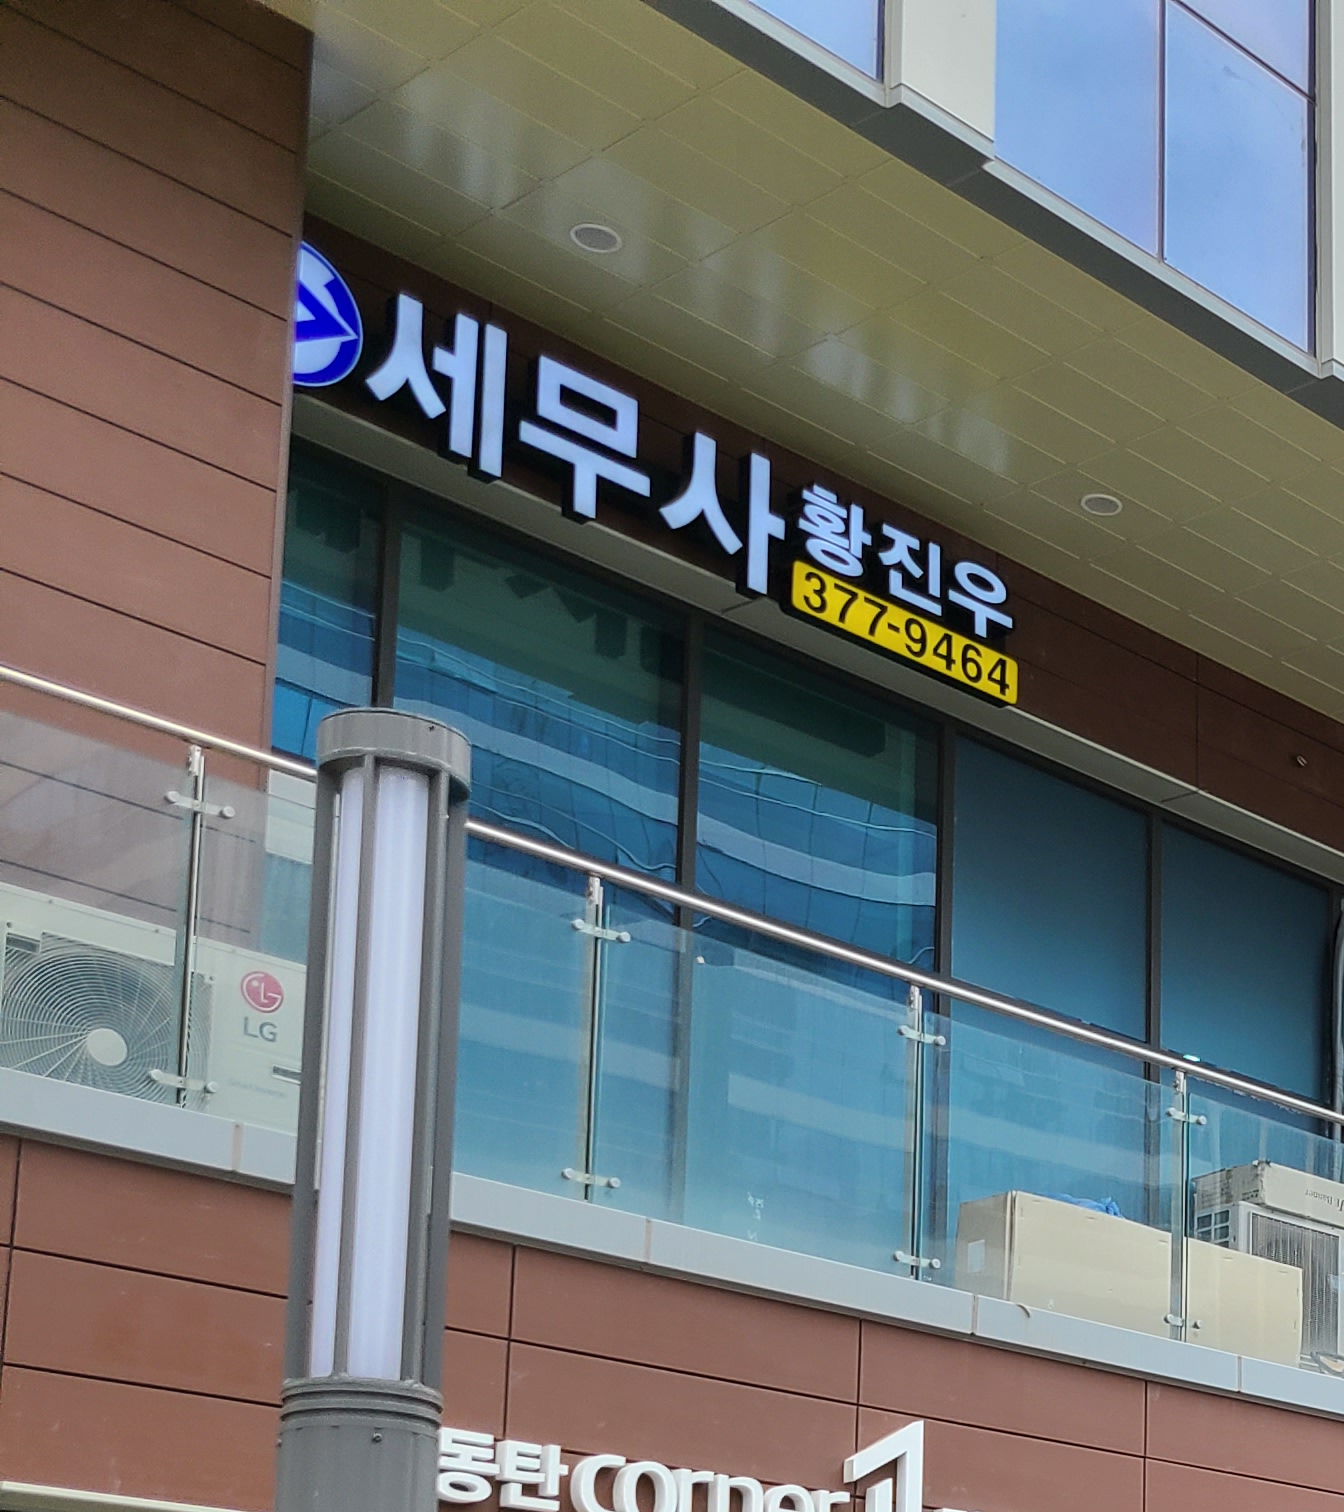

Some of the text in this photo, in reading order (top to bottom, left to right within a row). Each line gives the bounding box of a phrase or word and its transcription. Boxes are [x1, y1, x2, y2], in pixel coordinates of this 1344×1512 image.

[365, 294, 785, 595] 세무사
[799, 484, 1014, 638] 황진우
[802, 570, 1011, 697] 377-9464
[243, 1016, 278, 1042] LG
